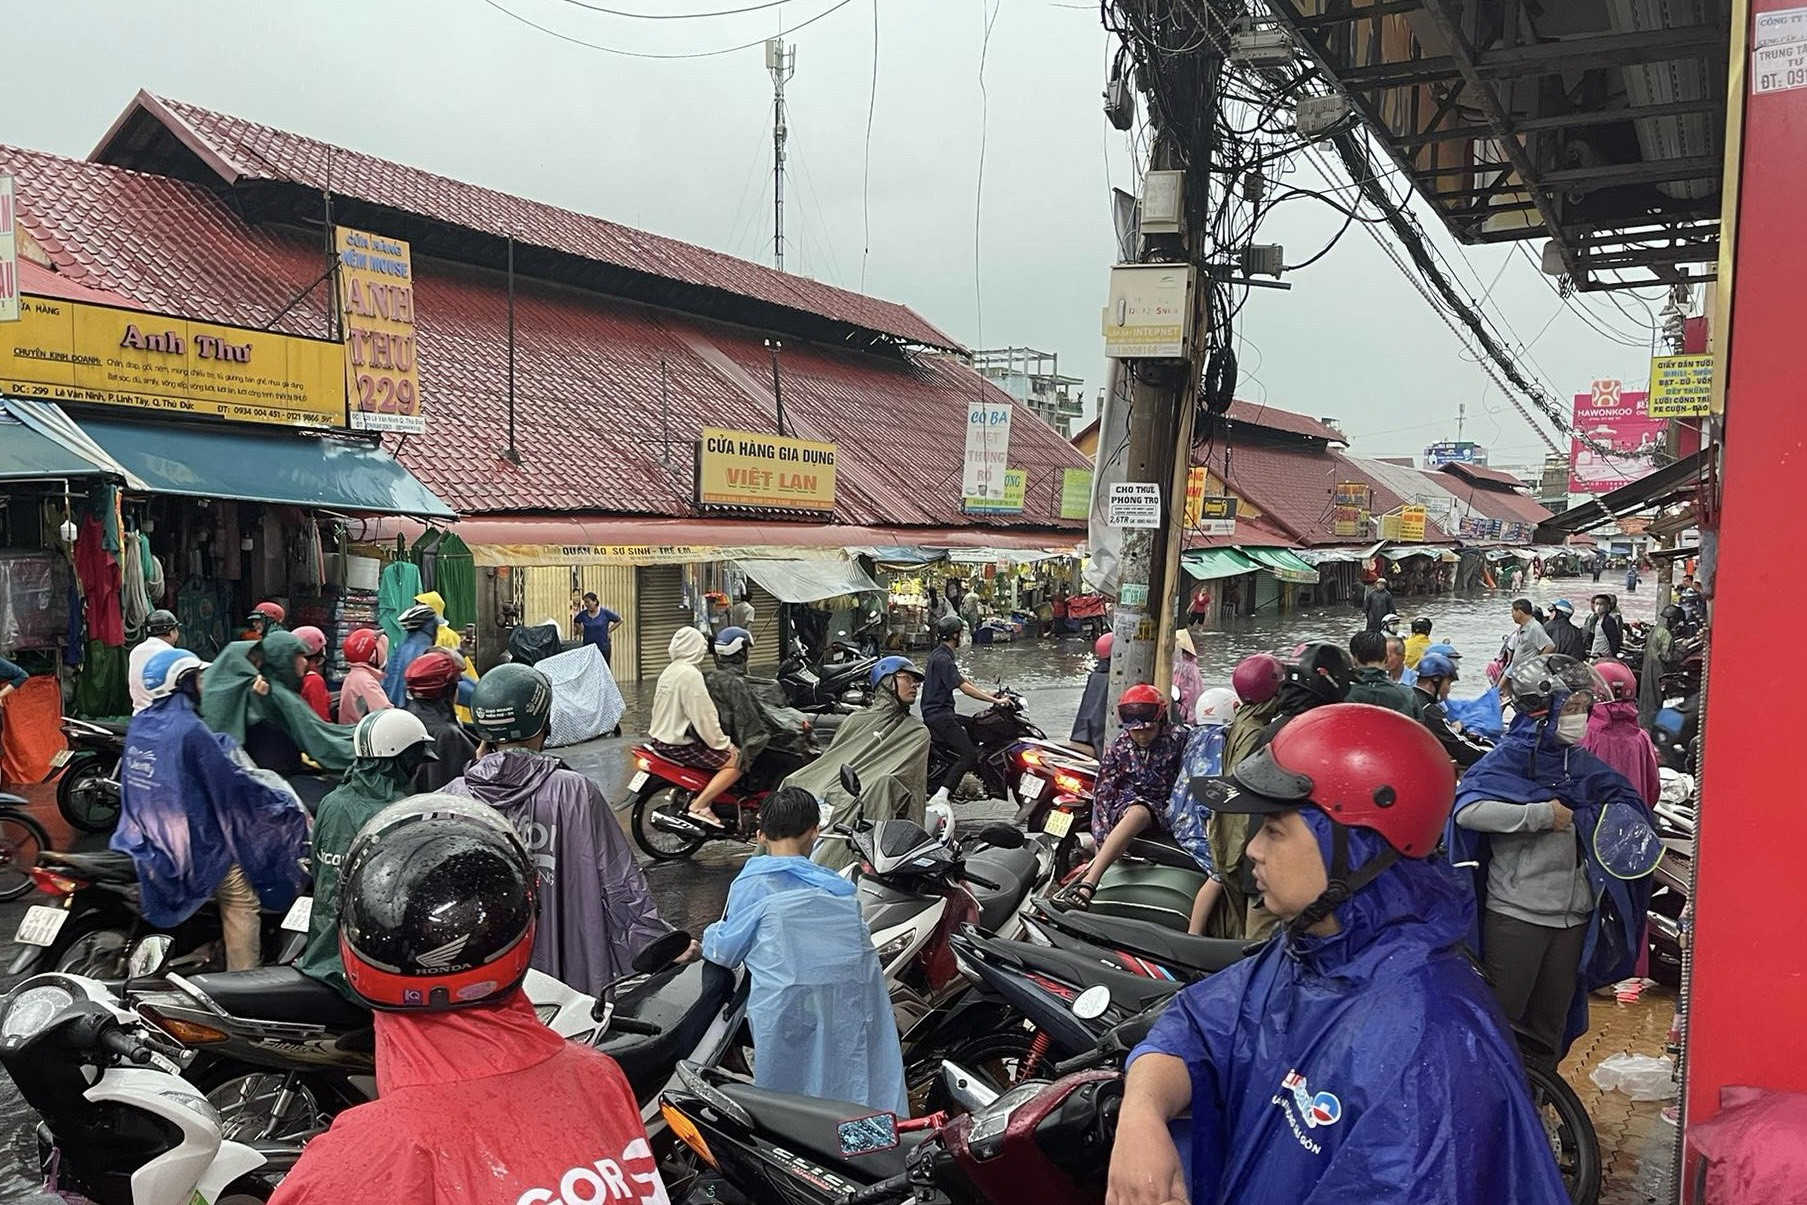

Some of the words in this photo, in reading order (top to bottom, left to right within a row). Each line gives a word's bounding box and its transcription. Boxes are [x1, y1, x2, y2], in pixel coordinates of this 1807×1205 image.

[1760, 48, 1793, 60] TRUNG
[1761, 73, 1782, 89] ĐT:
[344, 277, 414, 324] ANH
[36, 302, 60, 316] HÀNG
[120, 324, 186, 355] Anh
[194, 335, 253, 363] Thư
[350, 326, 416, 372] THƯ
[13, 348, 47, 360] CHUYÊN
[50, 351, 69, 362] KINH
[32, 386, 49, 395] 299
[357, 374, 416, 415] 229
[233, 406, 252, 416] 0934
[254, 408, 268, 418] 004
[990, 411, 1008, 426] BA
[1578, 408, 1632, 418] HAWONKOO
[707, 434, 735, 454] CỬA
[740, 440, 775, 459] HÀNG
[779, 446, 799, 462] GIA
[803, 449, 834, 466] DỤNG
[725, 467, 773, 493] VIỆT
[778, 473, 818, 494] LAN
[1116, 486, 1134, 494] CHO
[416, 963, 472, 975] HONDA
